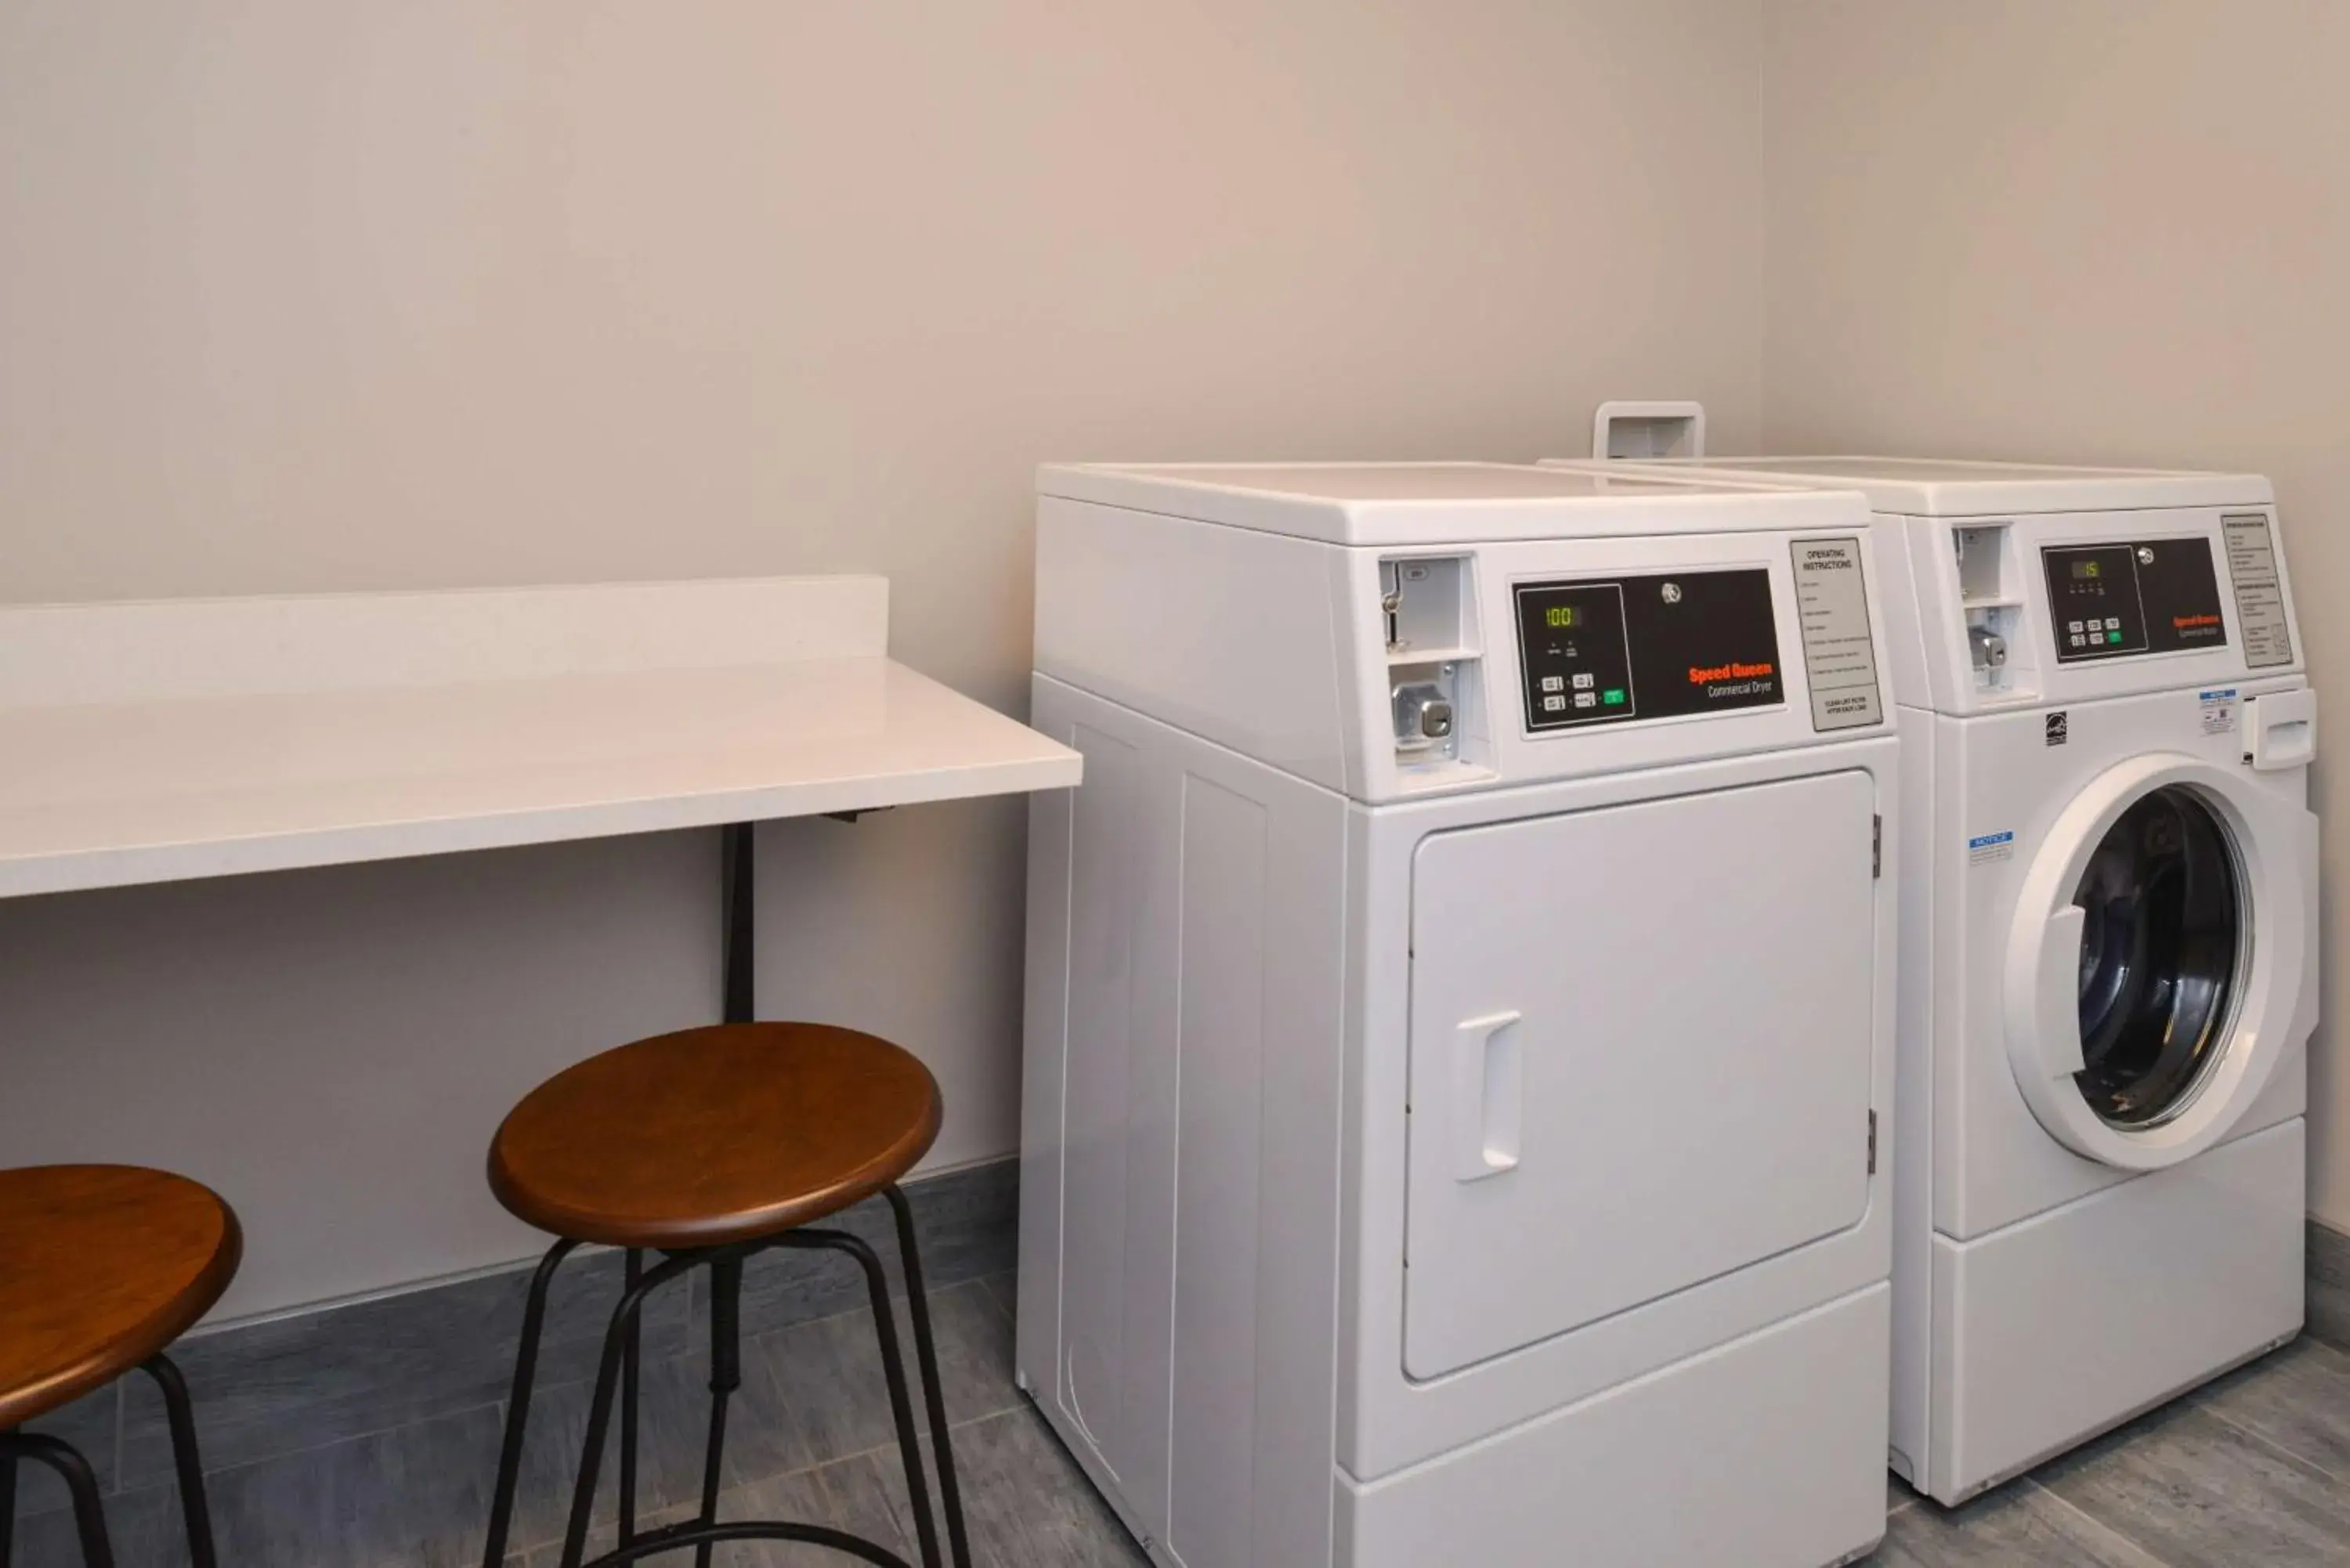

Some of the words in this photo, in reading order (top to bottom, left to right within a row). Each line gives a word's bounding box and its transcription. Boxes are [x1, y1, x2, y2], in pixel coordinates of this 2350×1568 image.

[1806, 549, 1845, 559] OPERATING
[1802, 560, 1852, 571] INSTRUCTIONS
[2086, 562, 2098, 576] 15
[1546, 607, 1571, 627] 100
[1690, 664, 1730, 685] Speed
[1732, 663, 1772, 677] Queen
[1708, 684, 1751, 698] Commercial
[1752, 681, 1772, 695] Dryer
